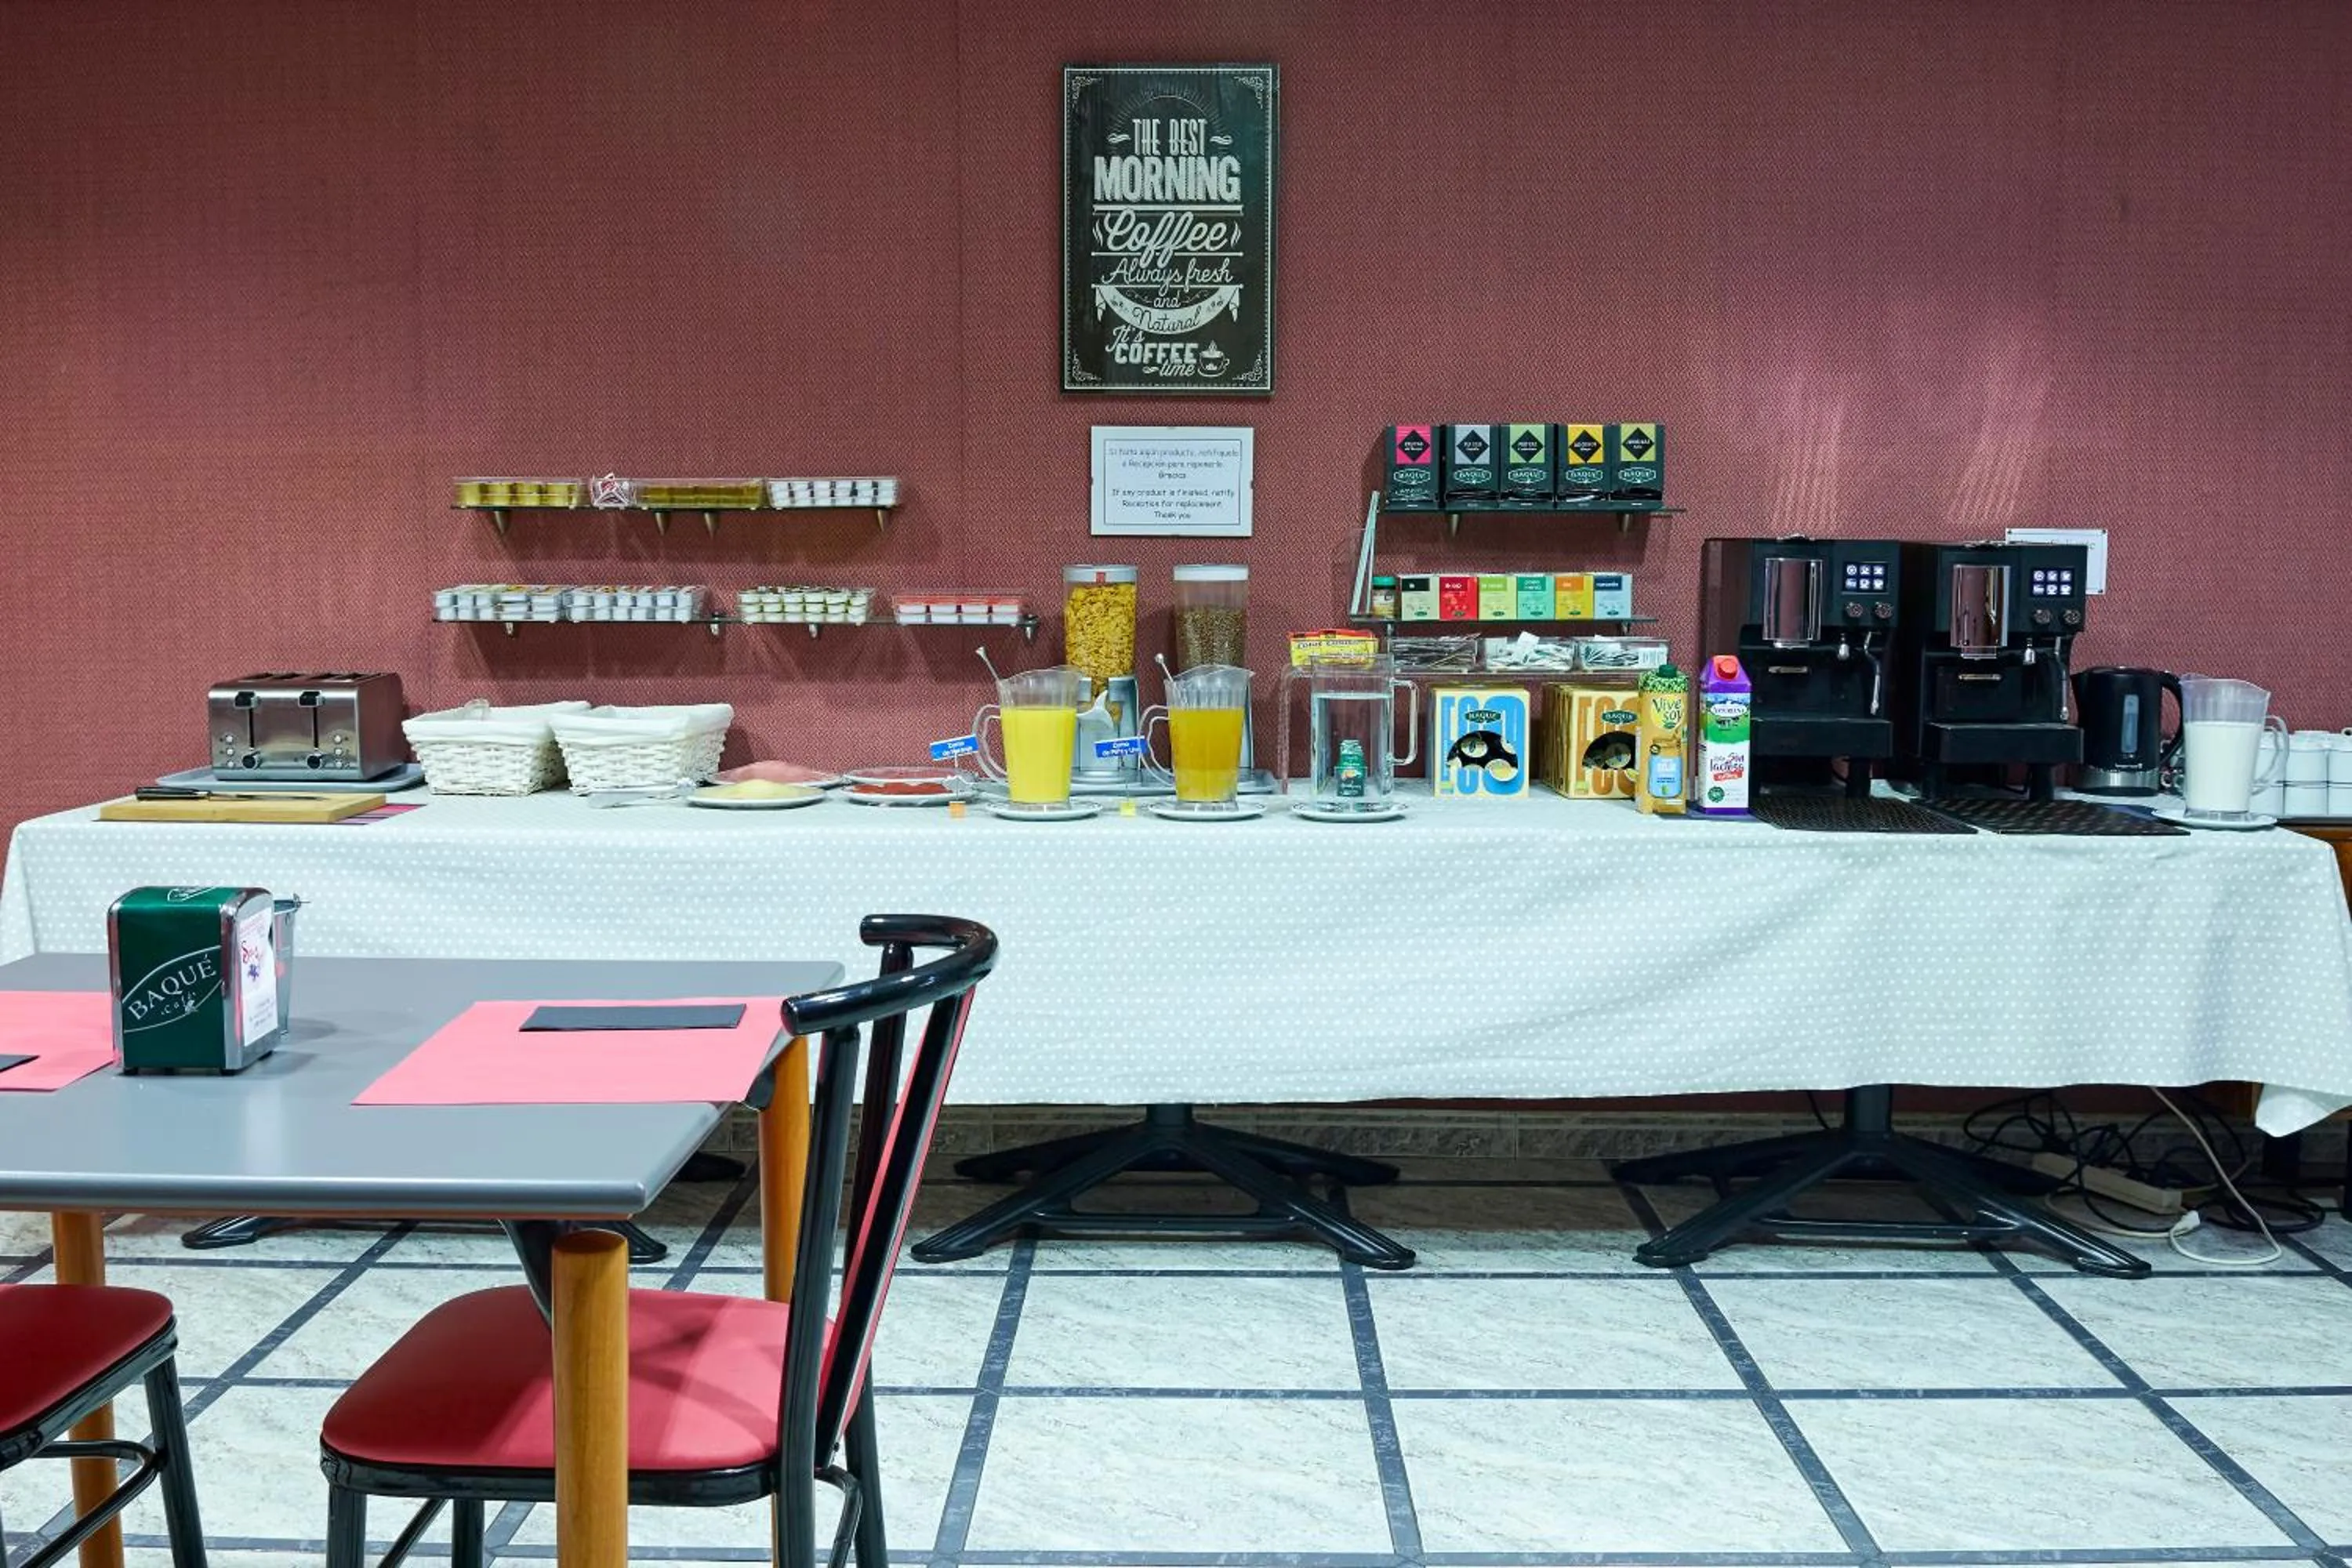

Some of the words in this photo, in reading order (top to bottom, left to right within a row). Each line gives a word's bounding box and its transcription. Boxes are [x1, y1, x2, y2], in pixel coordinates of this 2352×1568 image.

[1132, 118, 1160, 155] THE
[1169, 118, 1207, 155] BEST
[1094, 155, 1241, 201] MORNING
[1104, 208, 1228, 268] Coffee
[1102, 258, 1182, 296] Always
[1184, 258, 1232, 292] fresh
[1154, 289, 1181, 308] and
[1133, 307, 1202, 332] Natural
[1105, 325, 1145, 352] It's
[1114, 343, 1199, 365] COFFEE
[1160, 358, 1196, 376] time
[1652, 698, 1682, 713] Vive
[129, 954, 217, 1020] BAQUÉ
